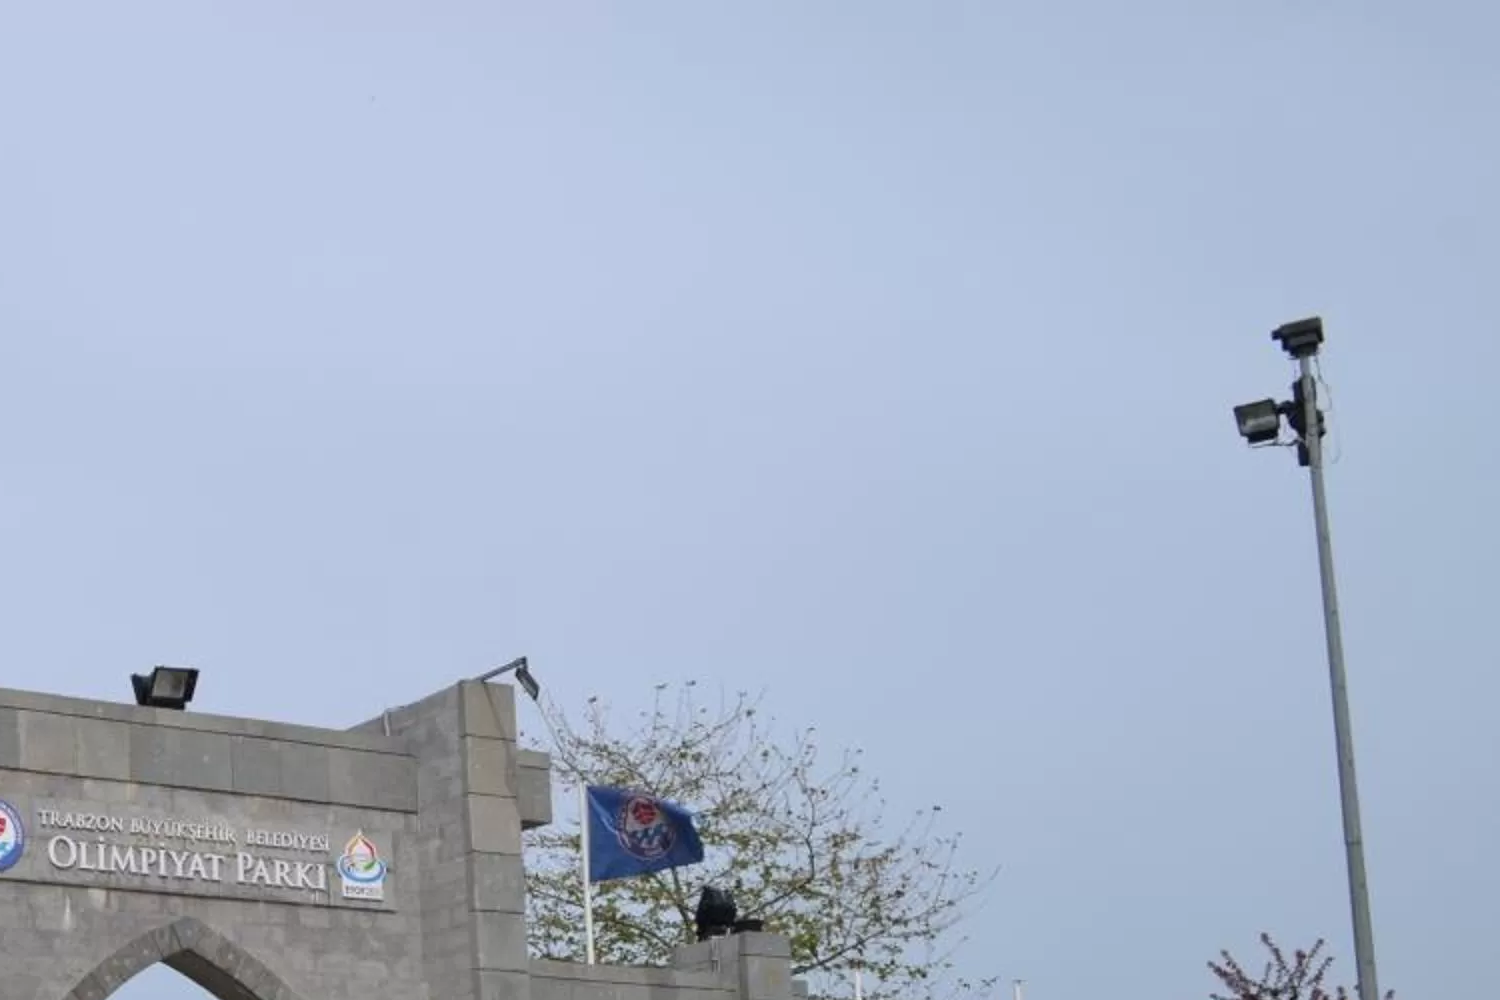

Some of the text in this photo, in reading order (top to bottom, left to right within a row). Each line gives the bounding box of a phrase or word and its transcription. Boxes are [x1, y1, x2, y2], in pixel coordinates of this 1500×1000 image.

[38, 810, 124, 832] TRABZON
[47, 835, 327, 890] OLİMPİYAT PARKI
